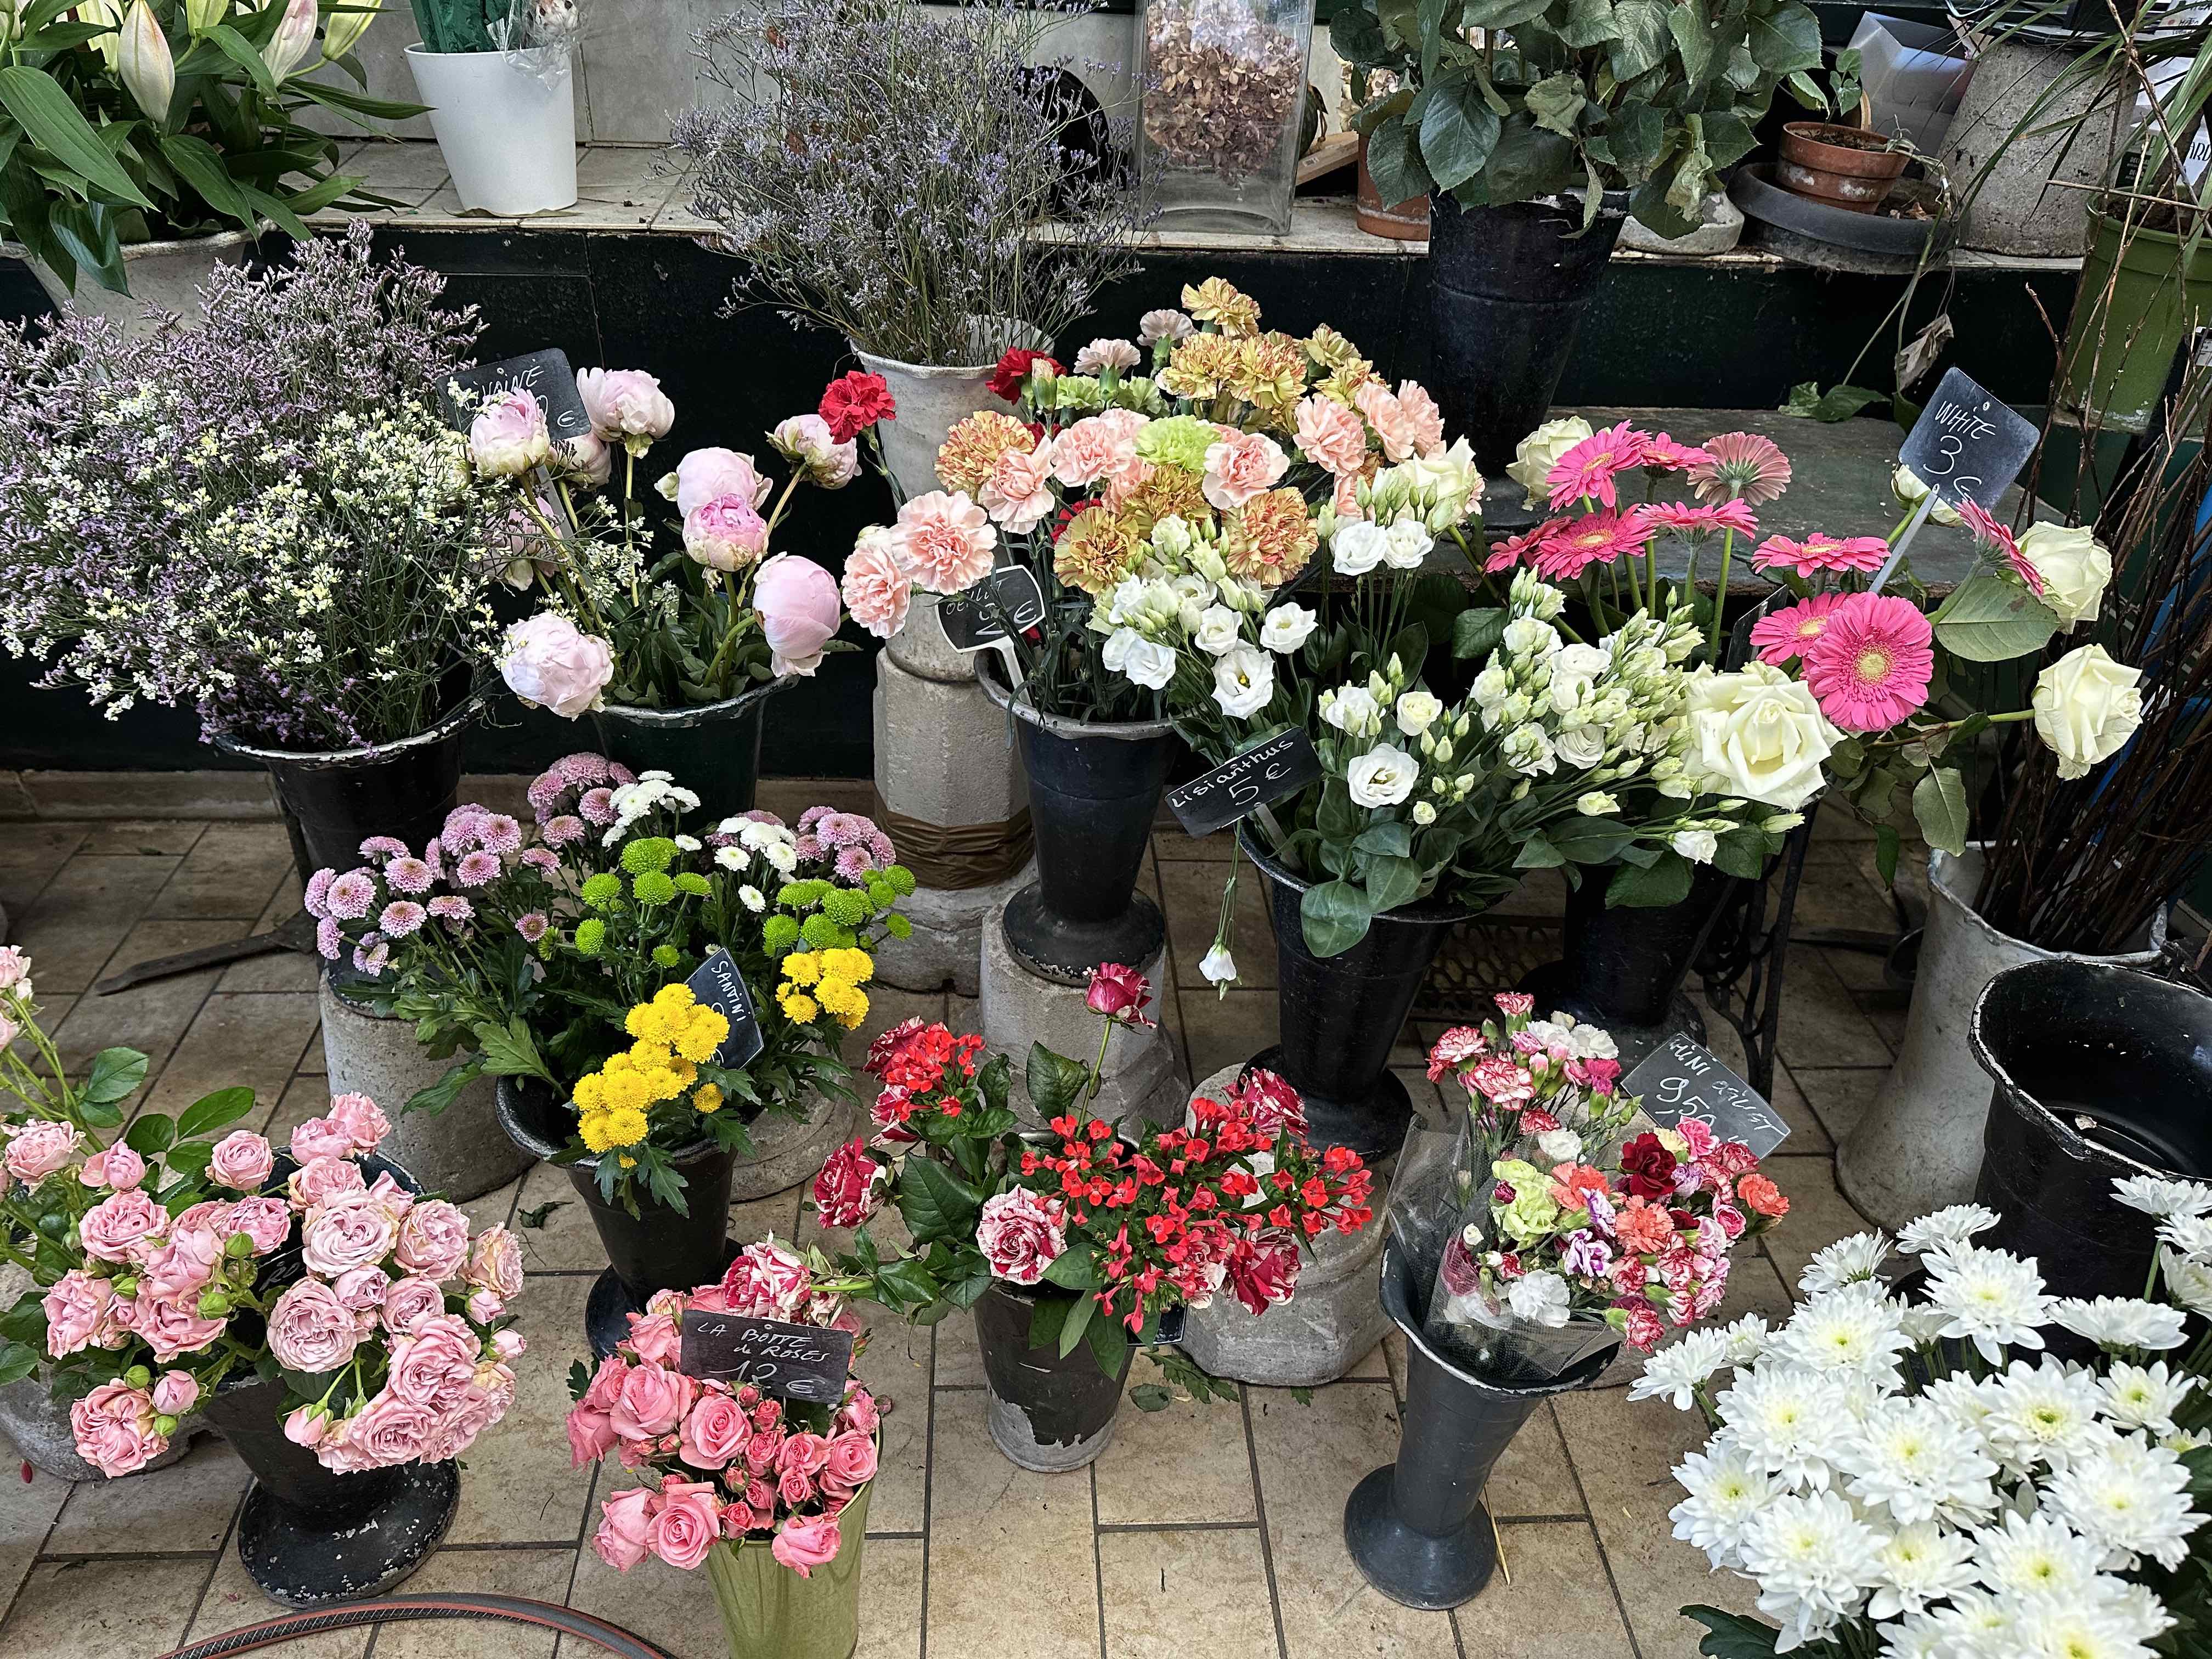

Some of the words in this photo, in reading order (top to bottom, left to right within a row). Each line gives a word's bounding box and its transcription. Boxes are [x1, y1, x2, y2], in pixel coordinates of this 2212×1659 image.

[557, 410, 575, 427] €
[1923, 435, 1962, 475] 3
[1013, 600, 1037, 624] €
[1172, 740, 1294, 808] Lisianthus
[1228, 776, 1259, 806] 5
[1265, 763, 1292, 781] €
[697, 1322, 727, 1337] LA
[741, 1329, 814, 1348] BOTTE
[733, 1345, 751, 1355] de
[760, 1345, 830, 1362] ROSES
[786, 1378, 826, 1399] €
